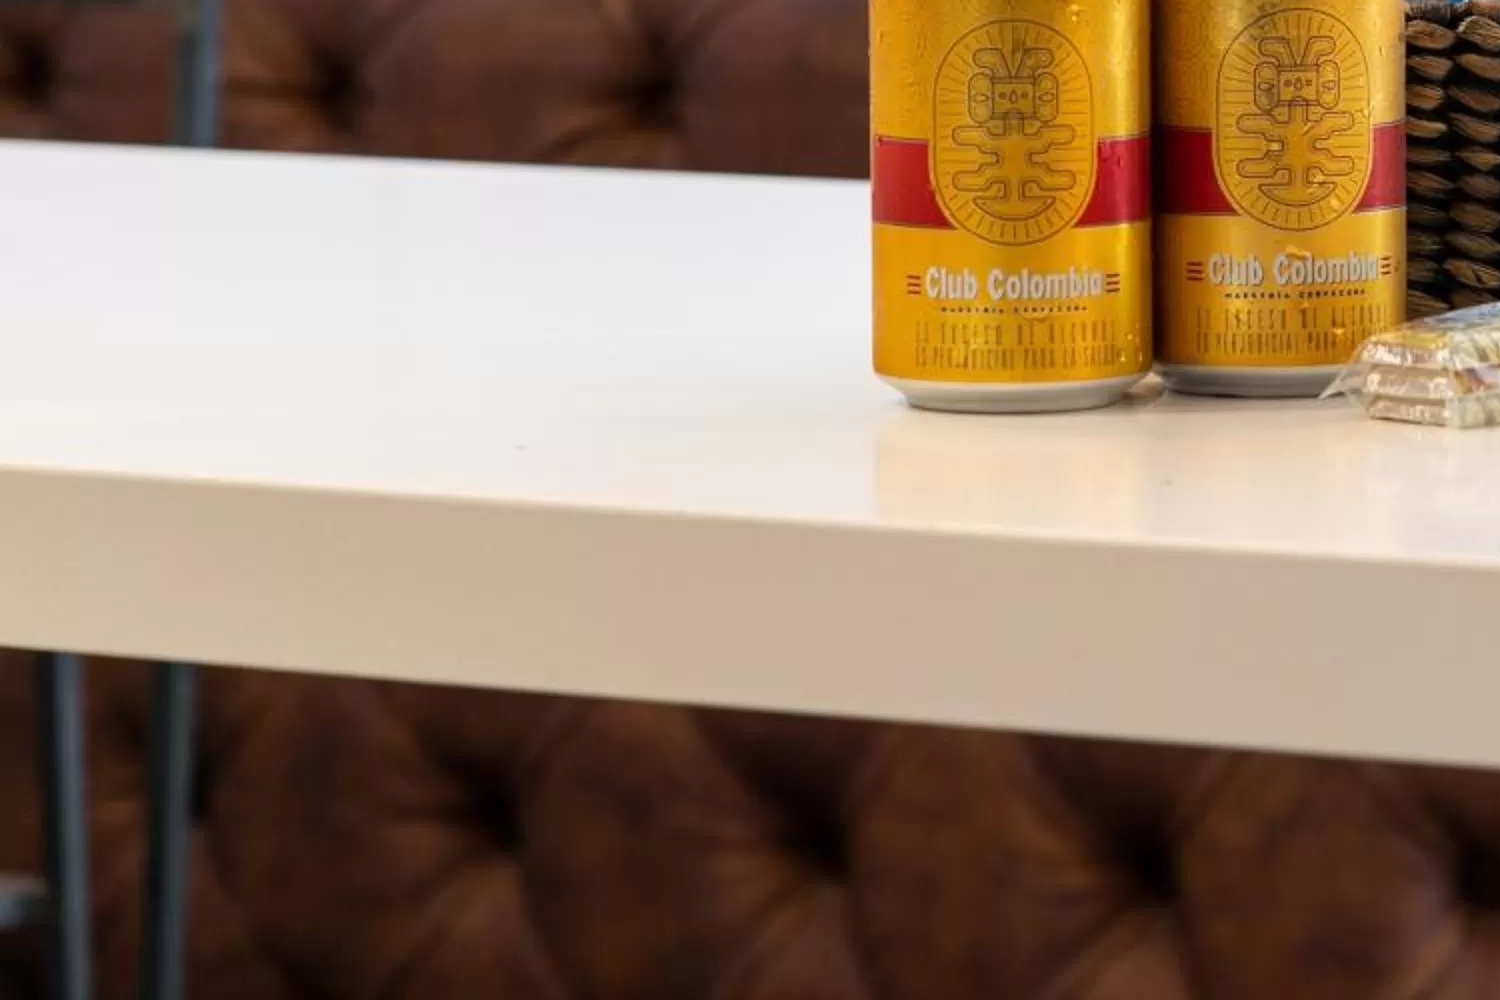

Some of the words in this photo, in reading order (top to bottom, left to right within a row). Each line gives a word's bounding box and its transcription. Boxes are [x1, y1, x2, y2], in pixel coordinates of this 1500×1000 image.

[926, 265, 977, 300] Club
[988, 264, 1103, 300] Colombia
[1208, 252, 1265, 287] Club
[1273, 252, 1380, 287] Colombia
